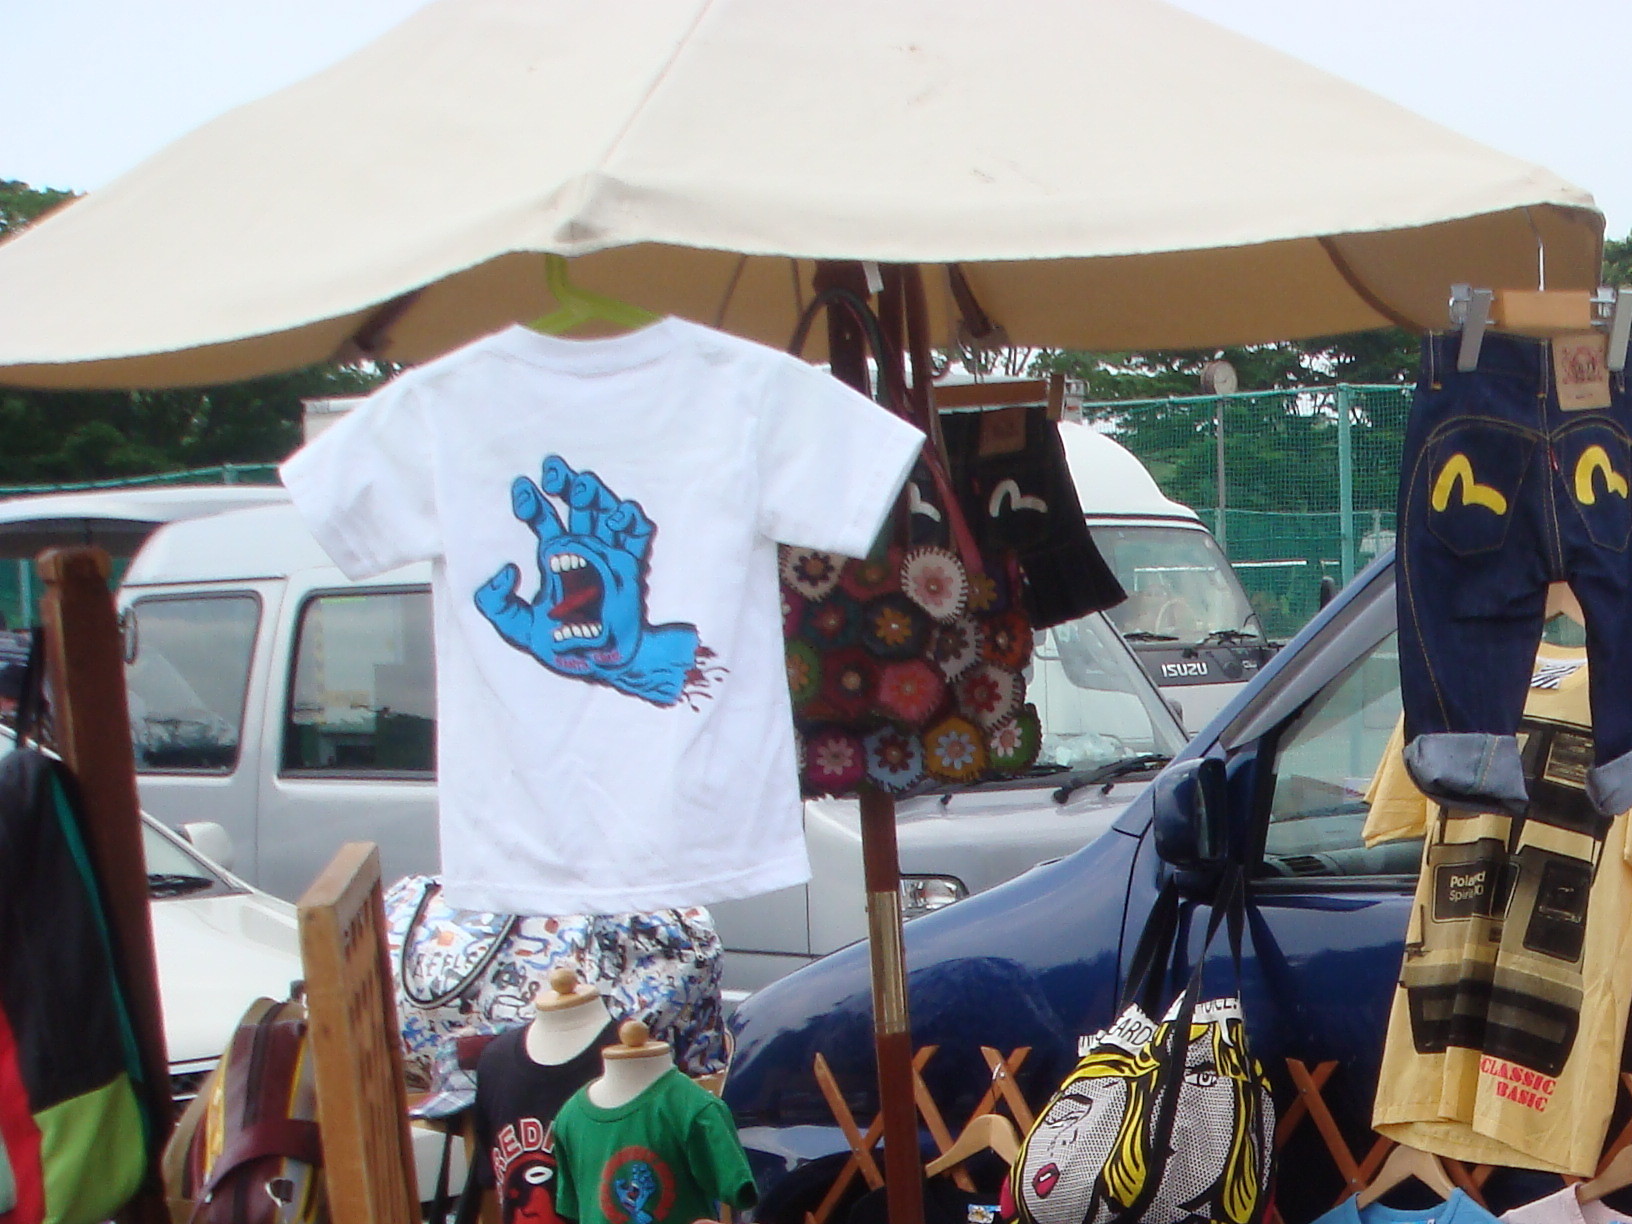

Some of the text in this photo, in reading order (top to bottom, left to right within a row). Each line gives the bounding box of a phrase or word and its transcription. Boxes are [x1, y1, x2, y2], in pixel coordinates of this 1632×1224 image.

[1161, 662, 1208, 677] ISUZU
[1480, 1056, 1557, 1096] CLASSIC
[1496, 1081, 1549, 1112] BASIC
